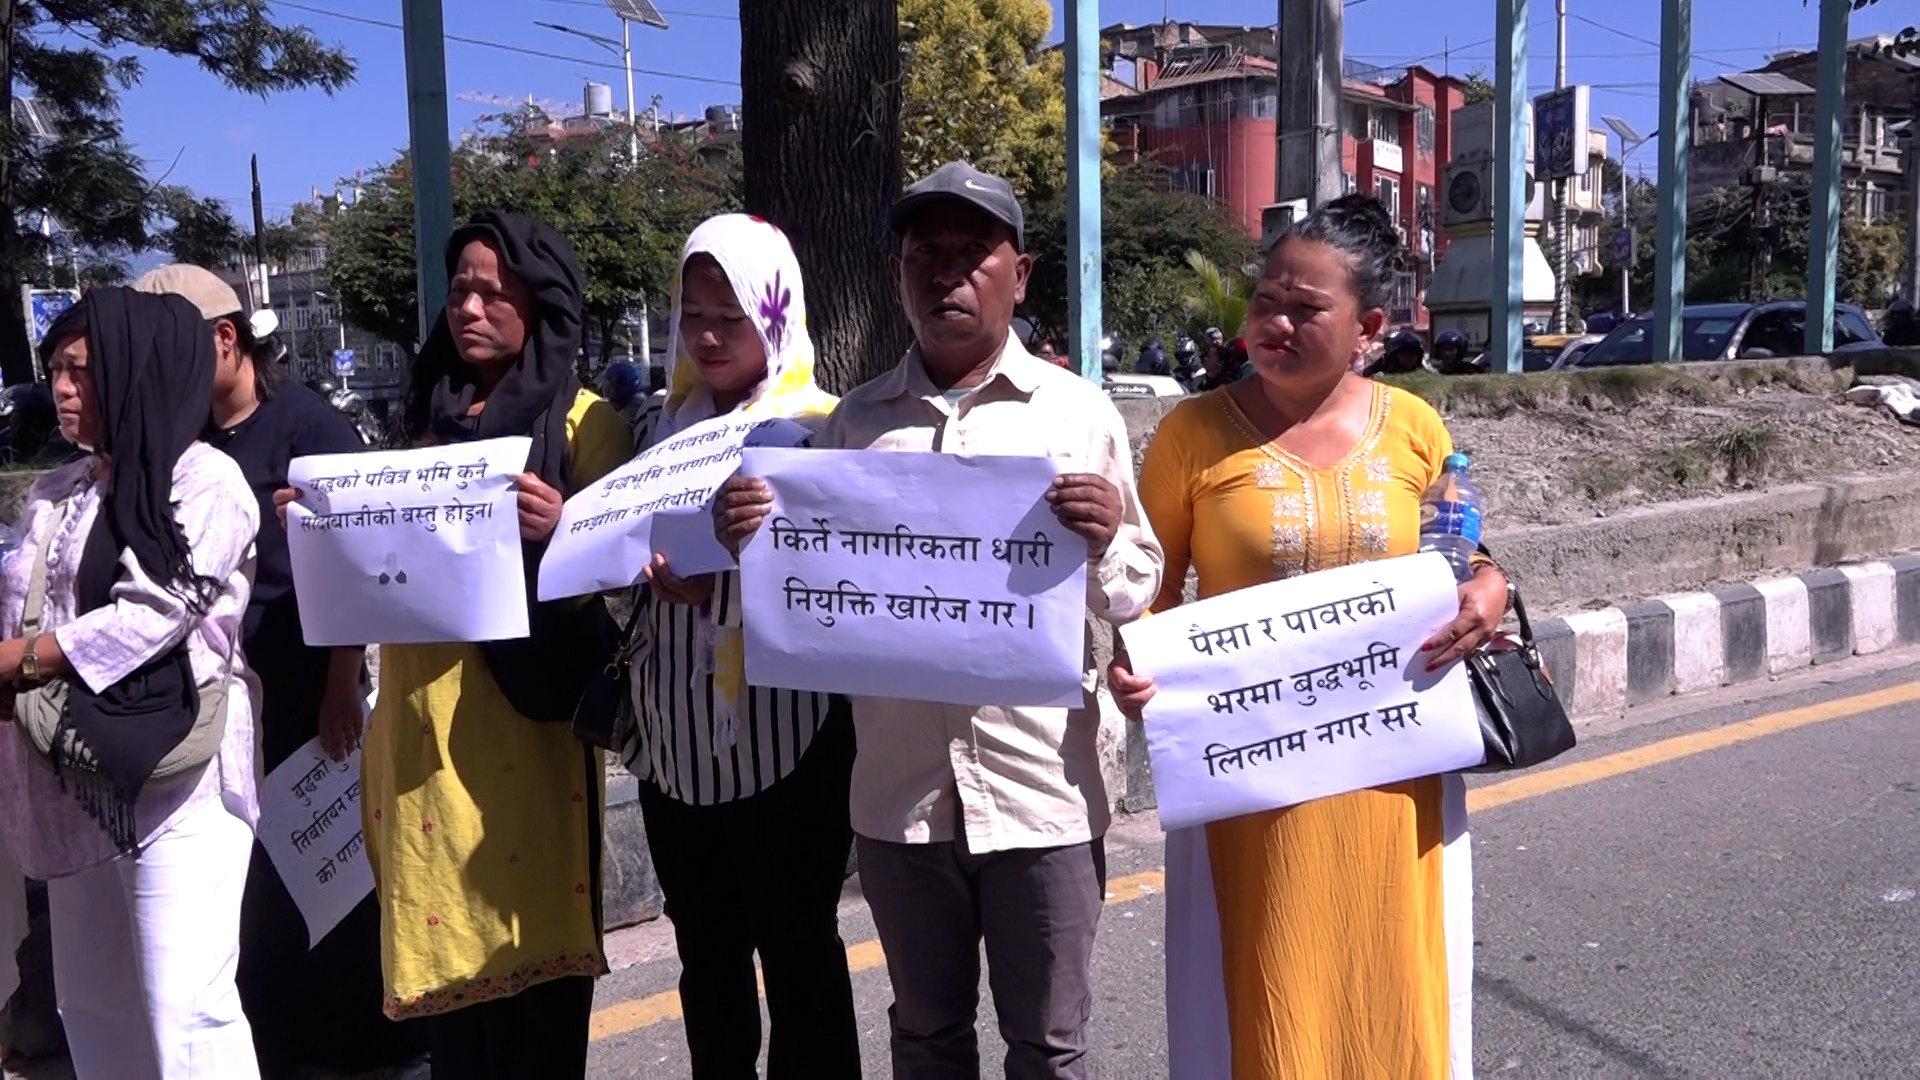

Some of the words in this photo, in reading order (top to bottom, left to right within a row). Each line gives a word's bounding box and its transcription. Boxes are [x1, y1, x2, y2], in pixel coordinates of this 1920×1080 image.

[416, 460, 453, 492] भूमि
[769, 517, 832, 553] किर्ते
[838, 523, 982, 562] नागरिकता
[991, 531, 1055, 568] धारी
[782, 576, 879, 628] नियुक्ति
[885, 585, 971, 623] खारेज
[978, 599, 1017, 628] गर
[1187, 622, 1252, 657] पैसा
[1257, 617, 1278, 642] र
[1281, 580, 1396, 634] पावरको
[1207, 679, 1283, 715] भरमा
[1289, 641, 1402, 707] बुद्धभूमि
[1203, 729, 1307, 777] लिलाम
[1314, 711, 1373, 746] नगर
[1377, 701, 1423, 732] सर
[315, 856, 337, 885] को
